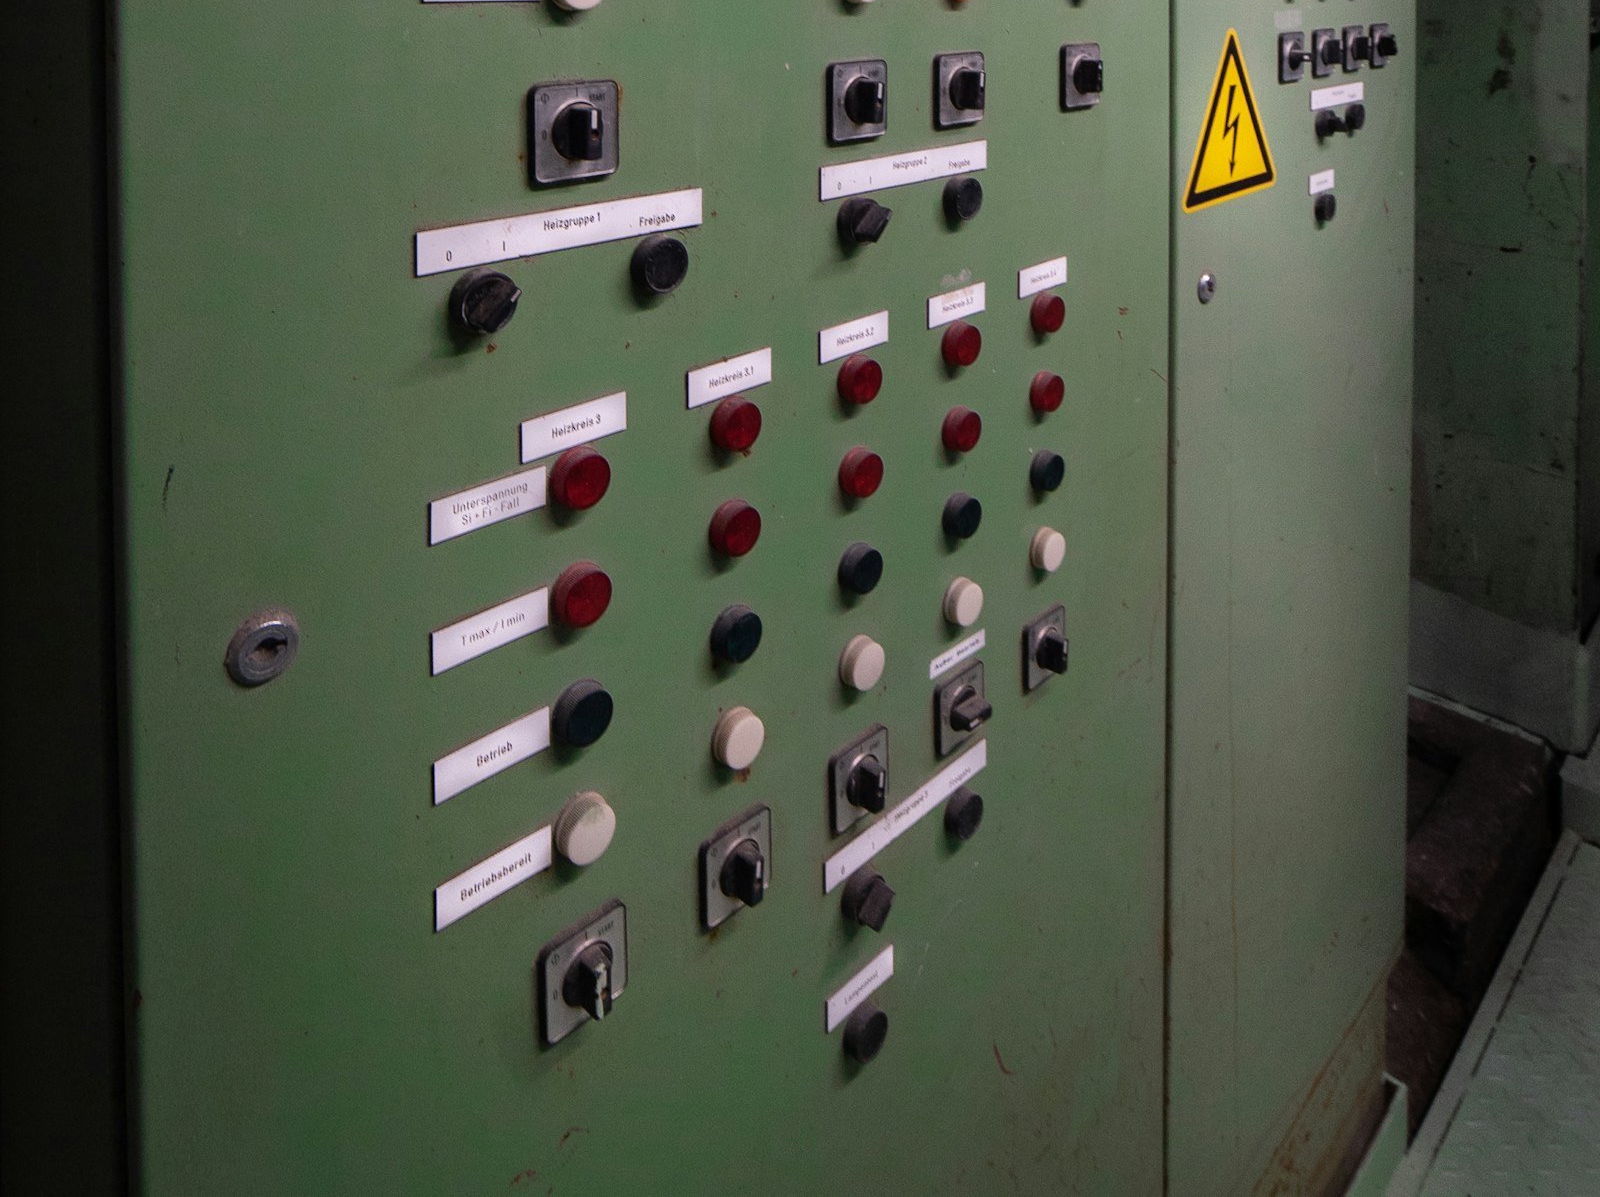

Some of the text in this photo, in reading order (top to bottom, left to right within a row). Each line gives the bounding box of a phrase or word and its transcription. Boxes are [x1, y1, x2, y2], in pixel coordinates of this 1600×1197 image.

[446, 250, 452, 262] 0
[543, 214, 595, 232] Heizgruppe
[638, 212, 676, 227] Freigabe
[551, 413, 602, 439] Heizkreis 3
[452, 481, 528, 515] Unterspannung
[461, 512, 472, 526] Si
[500, 496, 520, 512] Fall
[461, 634, 467, 646] T
[469, 626, 490, 644] max
[506, 611, 525, 627] min
[476, 740, 513, 768] Betrieb
[460, 852, 532, 902] Betriebsbereit
